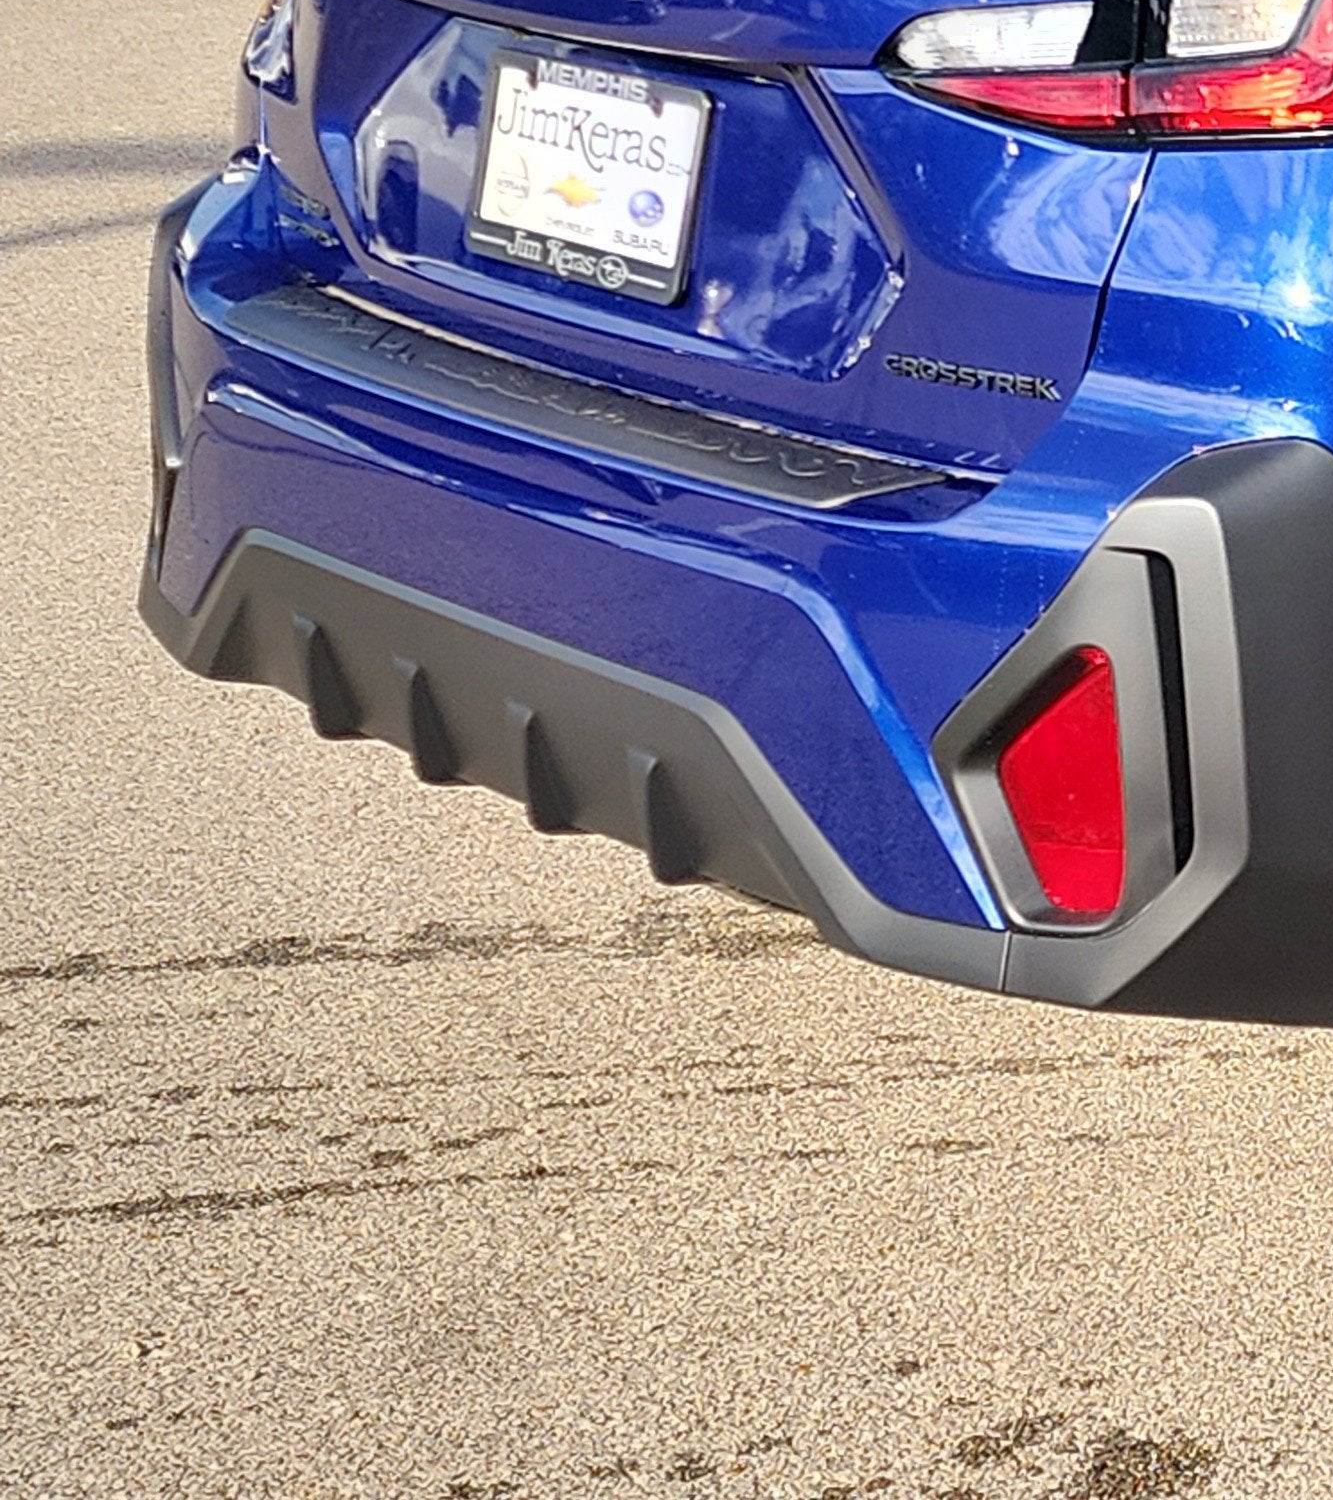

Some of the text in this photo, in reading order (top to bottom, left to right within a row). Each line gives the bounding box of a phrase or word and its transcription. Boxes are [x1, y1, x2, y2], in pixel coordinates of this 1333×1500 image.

[537, 59, 649, 105] MEMPHIS
[507, 229, 598, 277] Jim Keras
[612, 229, 669, 256] SUBARU
[884, 353, 1062, 402] CROSSTREK
